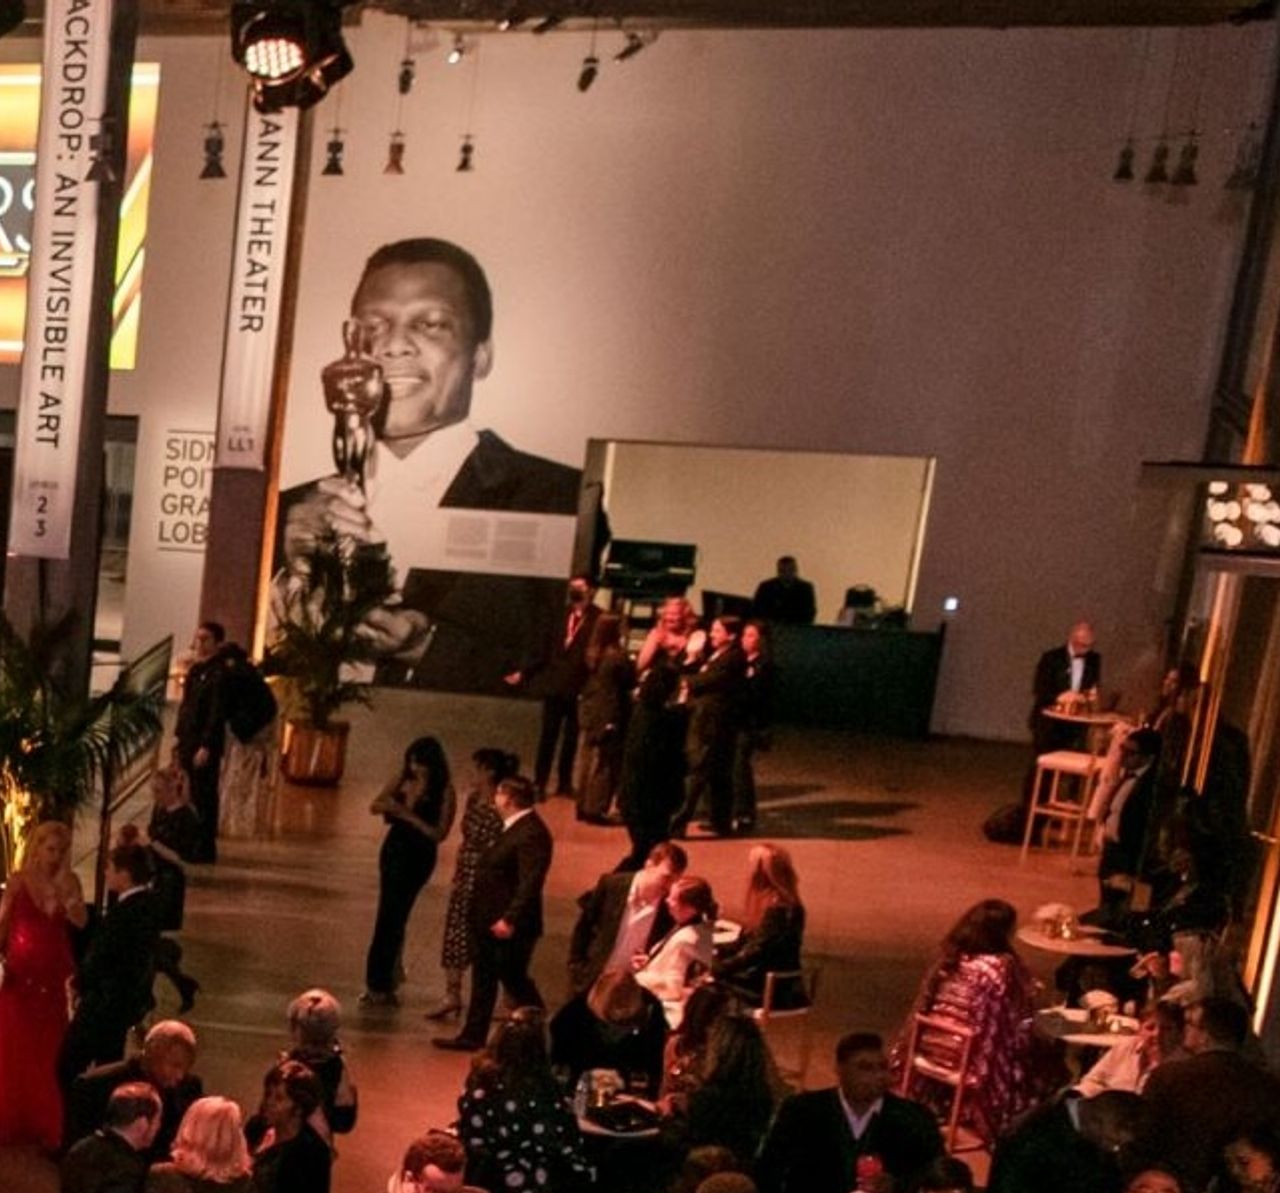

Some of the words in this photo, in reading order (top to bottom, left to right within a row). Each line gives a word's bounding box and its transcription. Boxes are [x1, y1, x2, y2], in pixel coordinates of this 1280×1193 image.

[254, 112, 282, 187] ANN
[53, 173, 79, 217] AN
[239, 200, 276, 333] THEATER
[40, 231, 77, 382] INVISIBLE
[35, 391, 62, 449] ART
[36, 495, 48, 514] 2
